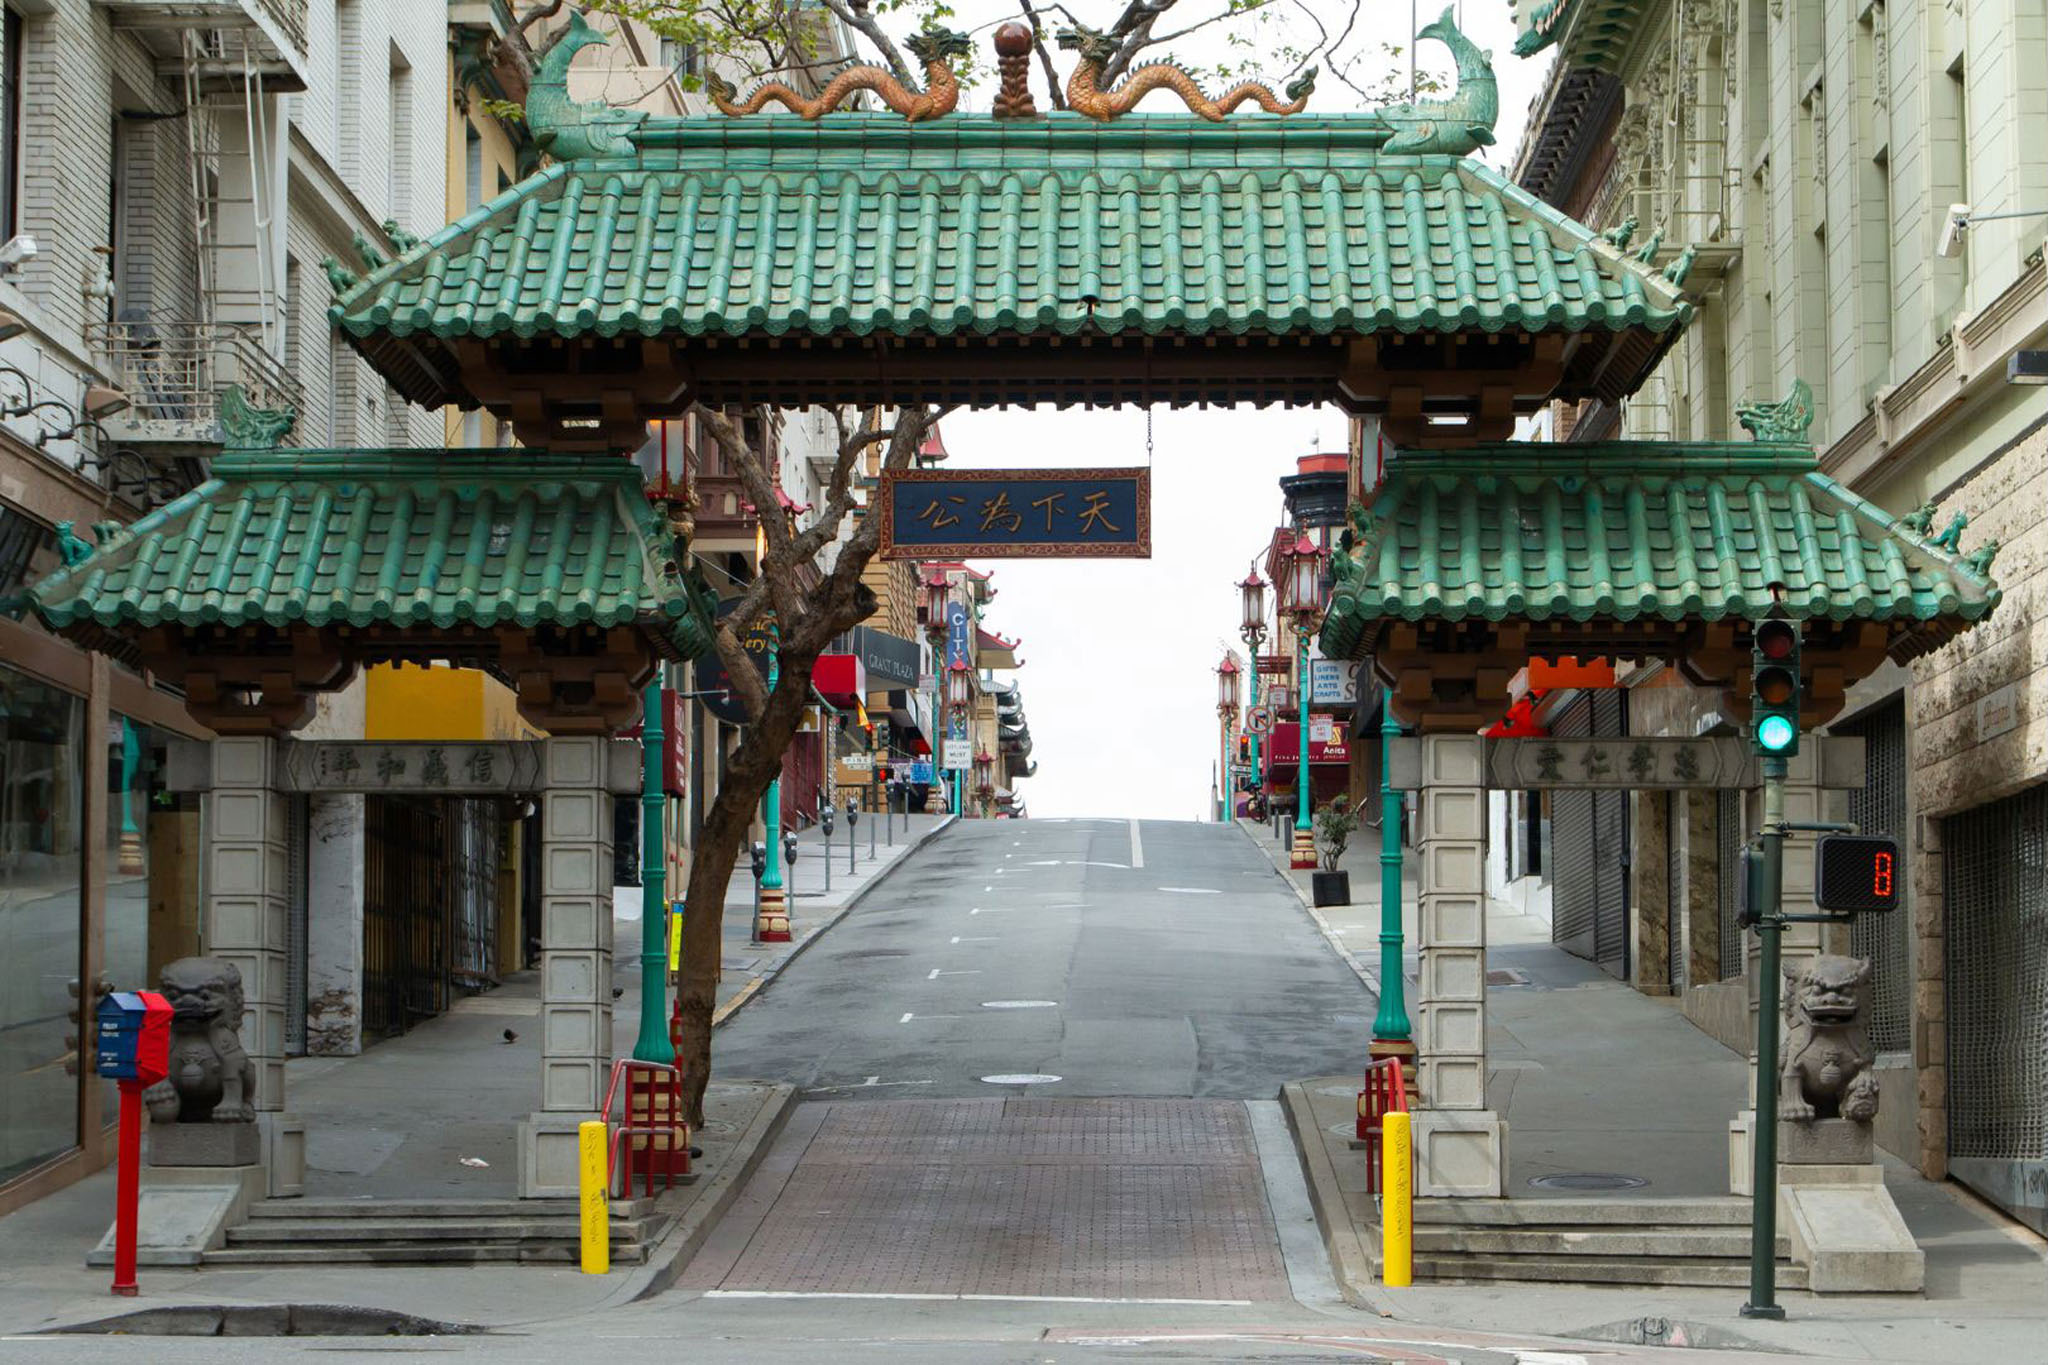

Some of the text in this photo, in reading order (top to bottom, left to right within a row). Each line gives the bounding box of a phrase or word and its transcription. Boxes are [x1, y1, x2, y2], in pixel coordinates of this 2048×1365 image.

[869, 653, 914, 680] GRANT PLAZA
[1316, 665, 1338, 673] GIFTS
[1323, 746, 1346, 755] Anita
[1875, 852, 1892, 896] 8
